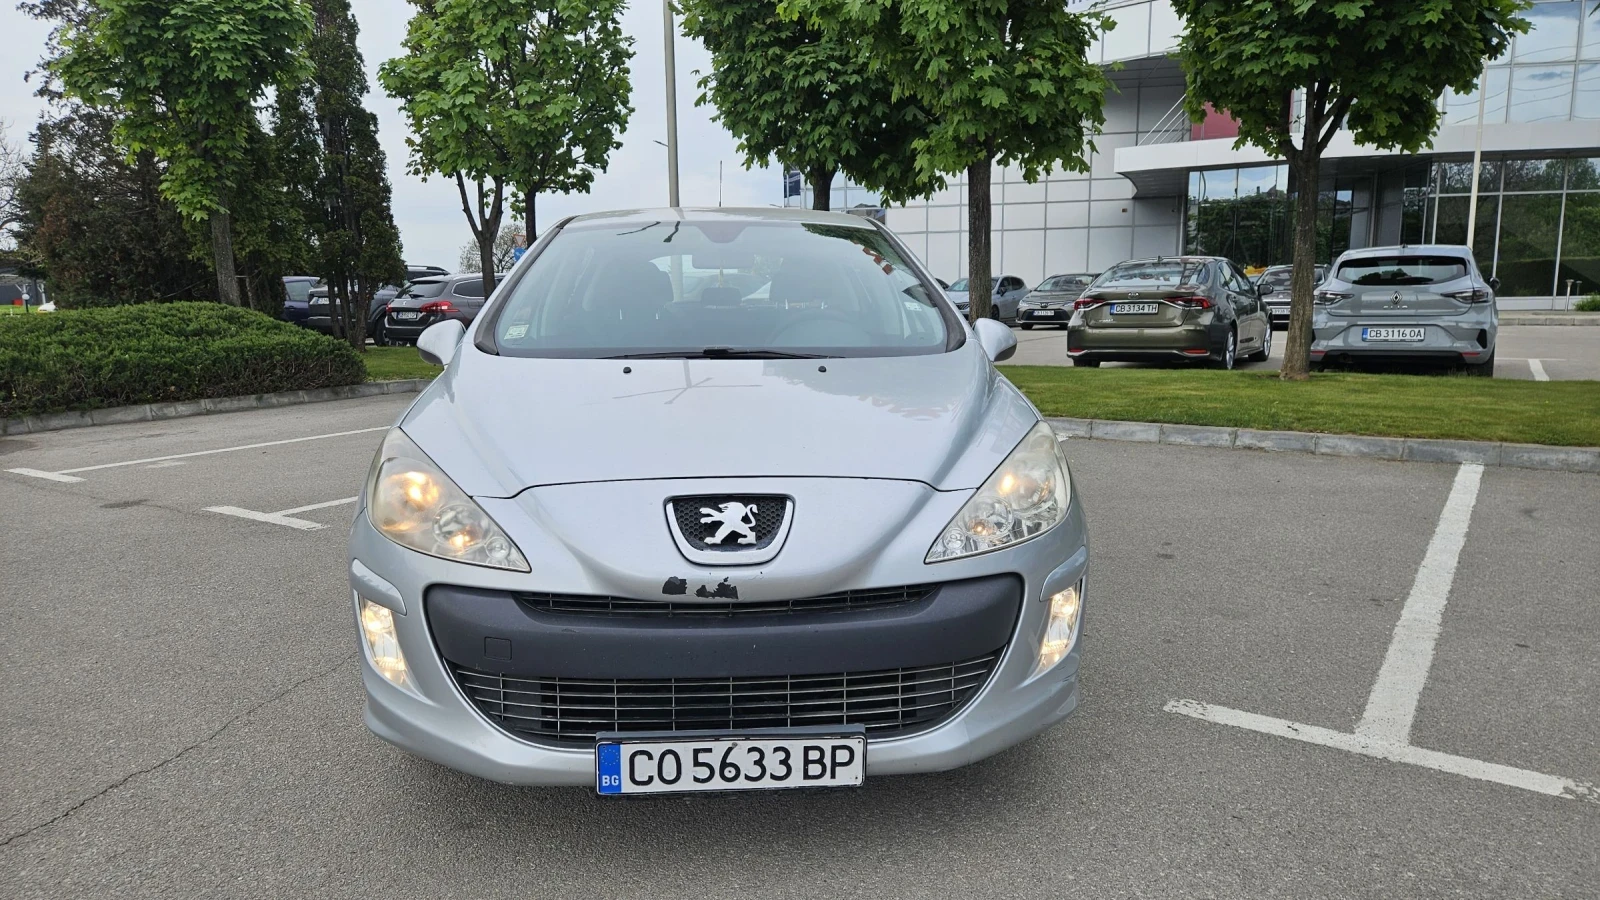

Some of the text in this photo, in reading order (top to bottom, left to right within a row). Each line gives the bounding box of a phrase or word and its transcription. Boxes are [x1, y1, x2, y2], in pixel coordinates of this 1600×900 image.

[1115, 304, 1157, 312] CB 3134 TH
[1369, 329, 1422, 338] CB 3116 OA
[628, 744, 855, 786] CO 5633 BP
[602, 775, 619, 786] BG
